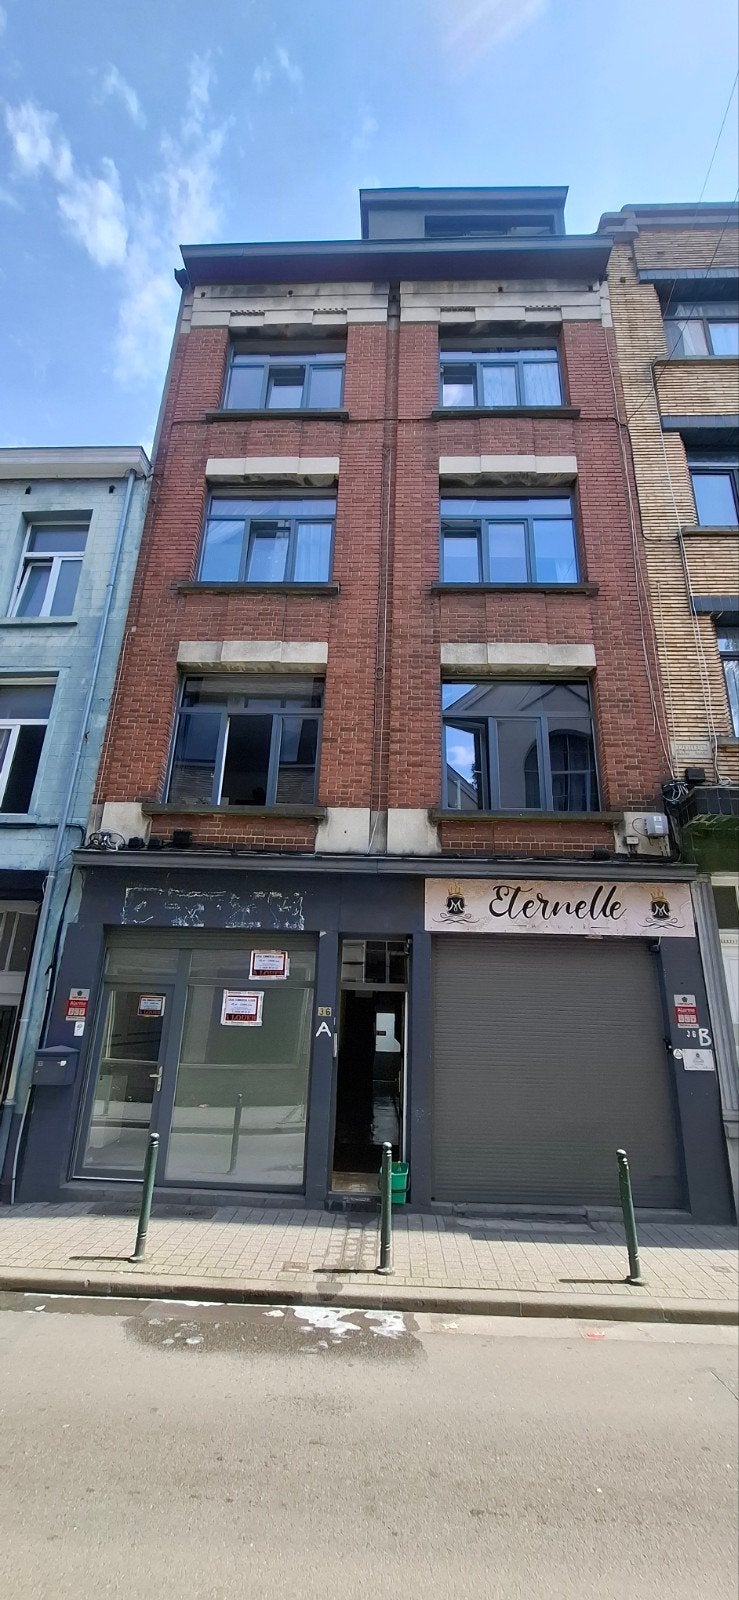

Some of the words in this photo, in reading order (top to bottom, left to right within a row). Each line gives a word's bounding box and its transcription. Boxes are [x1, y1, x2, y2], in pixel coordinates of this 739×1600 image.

[488, 885, 627, 920] Eternelle
[319, 1008, 331, 1016] 36
[315, 1021, 332, 1037] A
[698, 1028, 712, 1046] B
